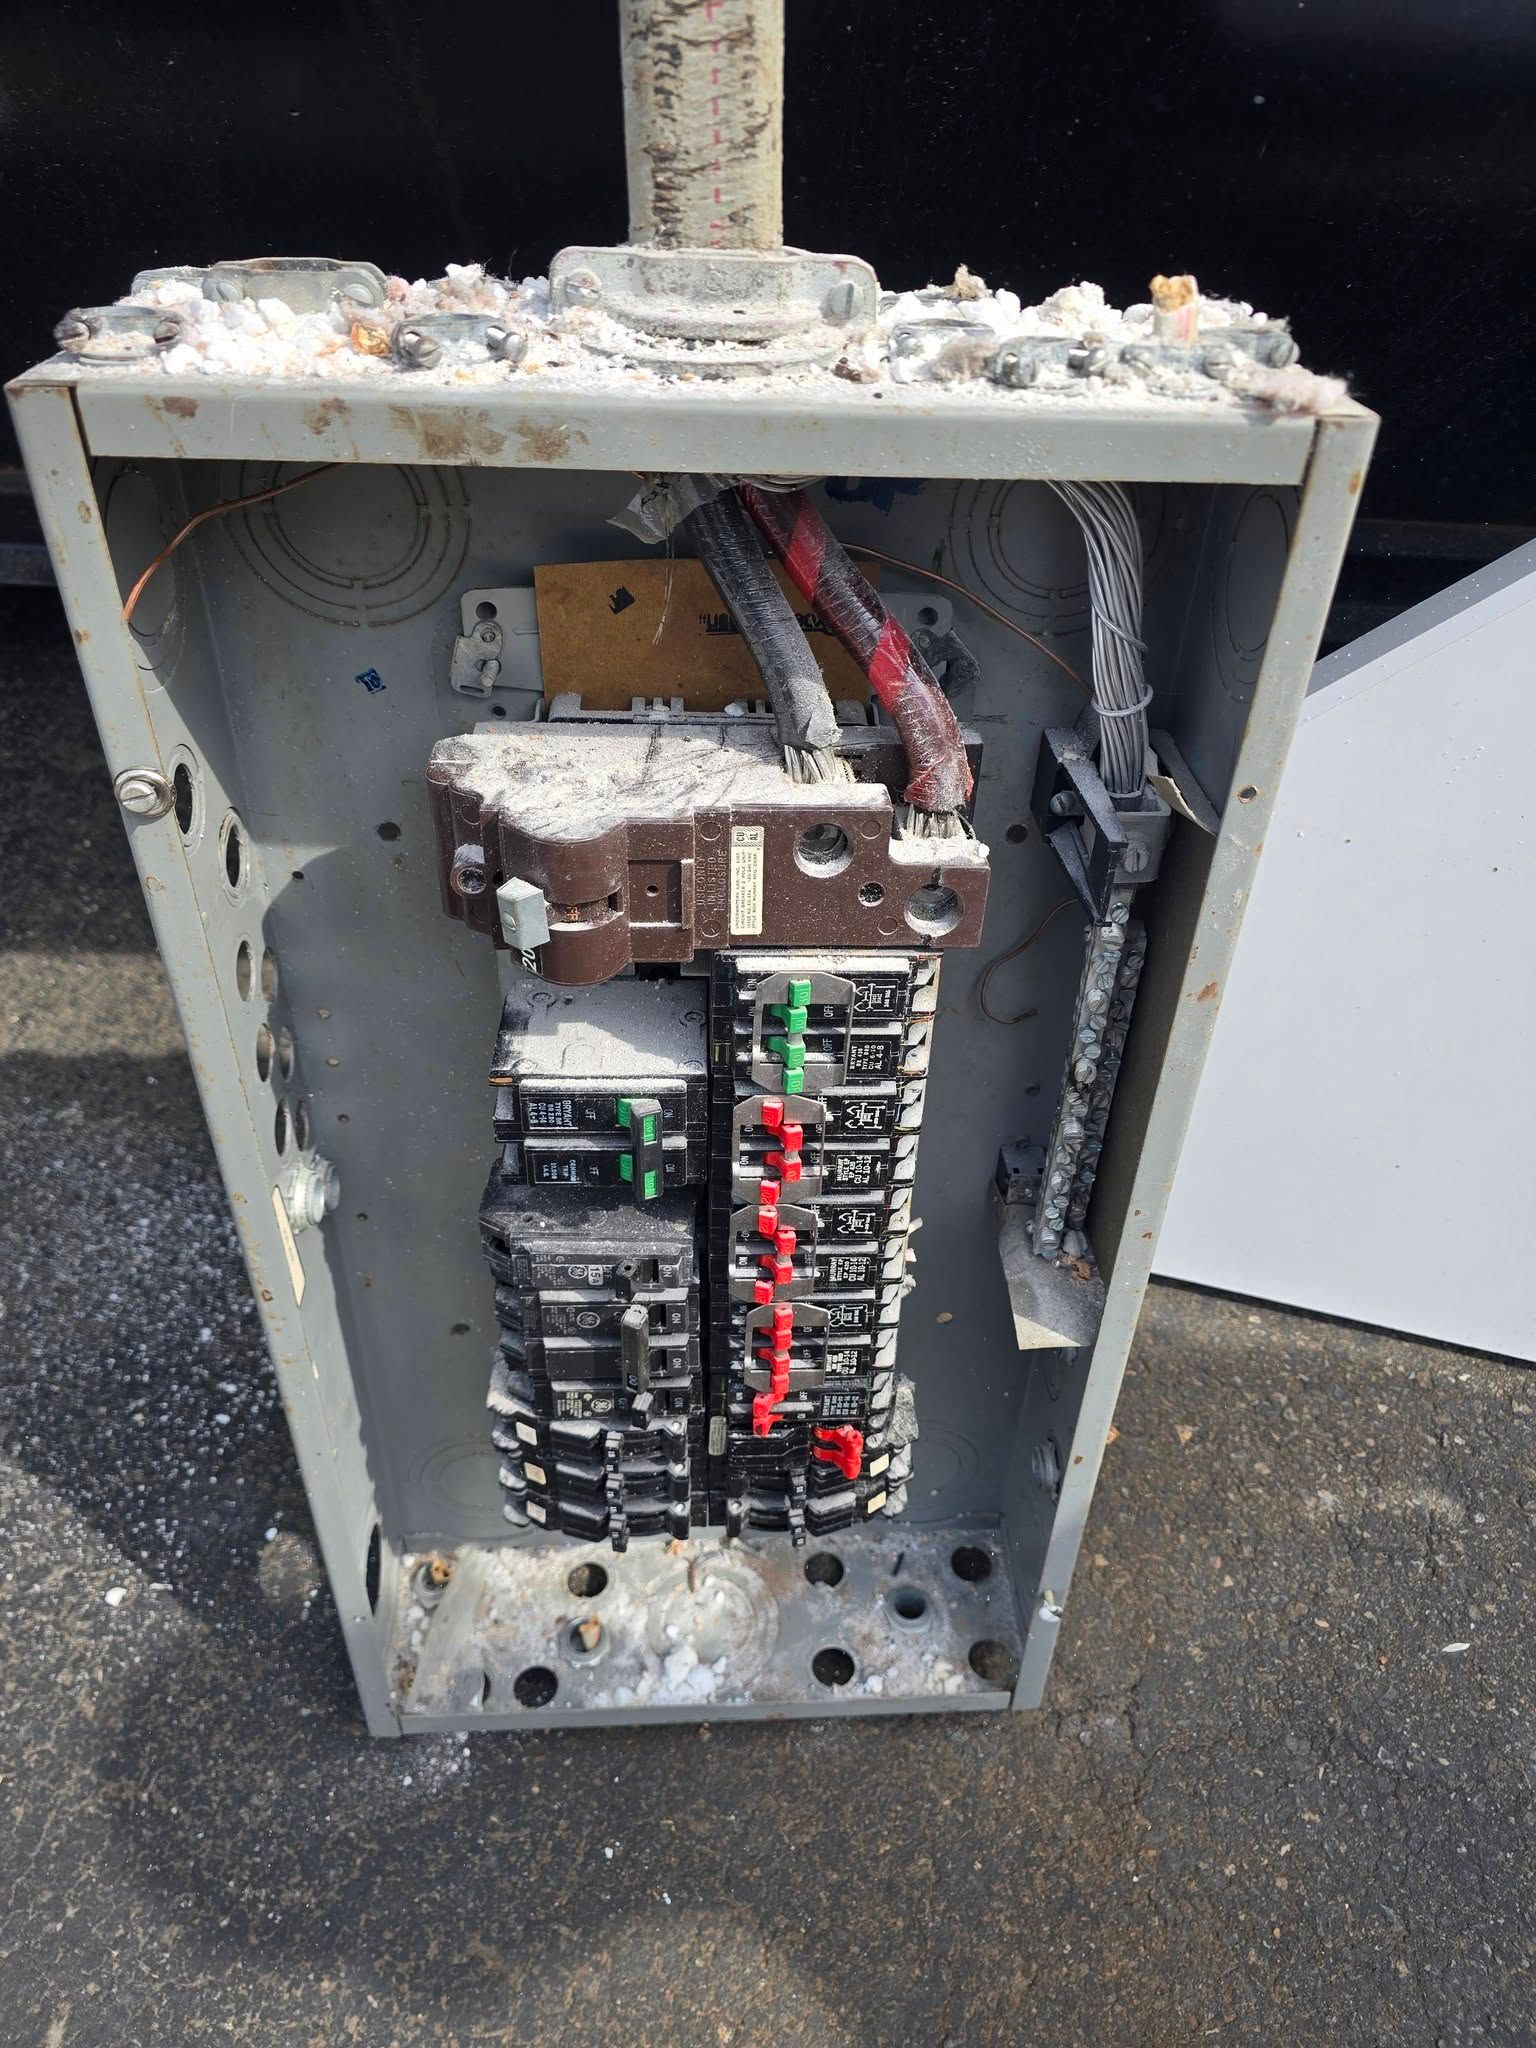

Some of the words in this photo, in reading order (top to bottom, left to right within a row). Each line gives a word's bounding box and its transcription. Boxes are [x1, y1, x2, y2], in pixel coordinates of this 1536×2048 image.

[736, 831, 745, 842] CU
[749, 832, 758, 841] AL
[696, 857, 705, 883] ONLY
[708, 857, 716, 892] LISTED
[718, 849, 726, 911] ENCLOSURE
[696, 886, 706, 905] USE
[824, 1005, 833, 1017] OFF
[823, 1038, 832, 1051] OFF
[875, 1060, 882, 1070] AL
[563, 1100, 572, 1127] BRYANT
[664, 1109, 673, 1118] ON
[740, 1156, 749, 1165] ON
[810, 1152, 819, 1163] OFF
[666, 1164, 674, 1173] ON
[663, 1267, 672, 1277] ON
[829, 1258, 837, 1281] MURRAY
[672, 1313, 681, 1323] ON
[672, 1358, 681, 1368] ON
[799, 1391, 808, 1400] OFF
[675, 1398, 684, 1408] ON
[822, 1395, 831, 1415] BRYANT
